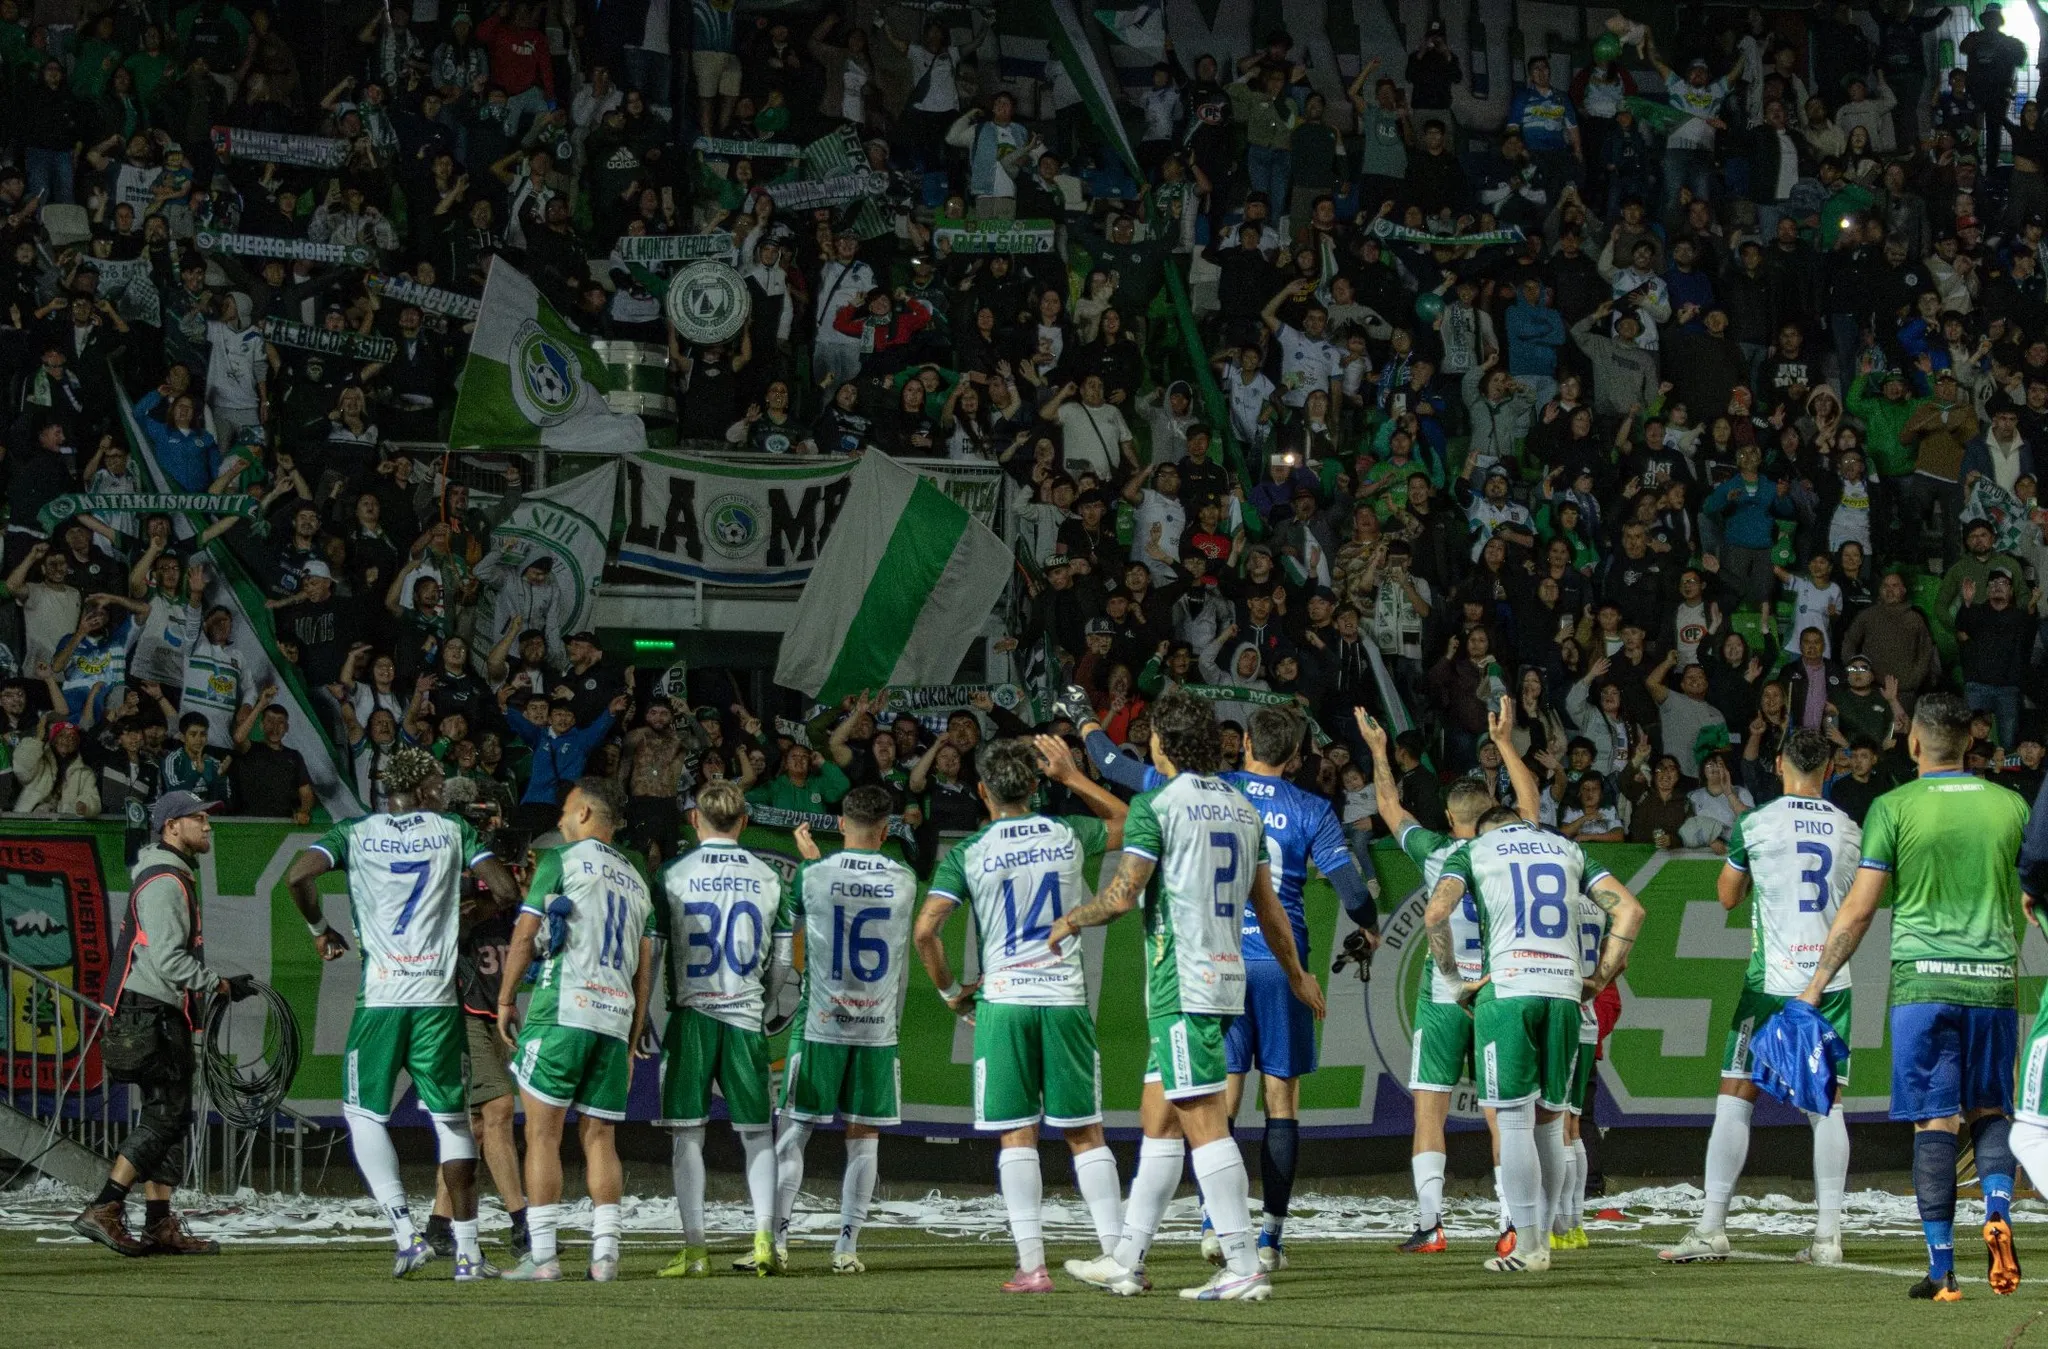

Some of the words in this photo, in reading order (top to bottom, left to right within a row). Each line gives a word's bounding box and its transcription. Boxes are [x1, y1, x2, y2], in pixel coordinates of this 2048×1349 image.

[638, 237, 677, 259] MONTE
[995, 233, 1037, 252] SUR
[624, 459, 704, 562] LA
[1187, 804, 1254, 825] MORALES
[1263, 811, 1288, 830] AO
[1795, 819, 1834, 836] PINO
[363, 834, 453, 854] CLERVEAUX
[983, 845, 1075, 873] CARDENAS
[1497, 842, 1568, 857] SABELLA
[583, 861, 598, 876] R.
[601, 864, 645, 900] CASTRO
[689, 877, 762, 895] NEGRETE
[830, 882, 895, 899] FLORES
[1210, 831, 1238, 918] 2
[1796, 841, 1834, 913] 3
[390, 860, 431, 936] 7
[1003, 871, 1064, 957] 14
[1510, 862, 1568, 939] 18
[600, 889, 628, 971] 11
[1385, 890, 1429, 950] DEPO
[684, 900, 763, 979] 30
[832, 905, 891, 983] 16
[1790, 943, 1824, 953] ticketp
